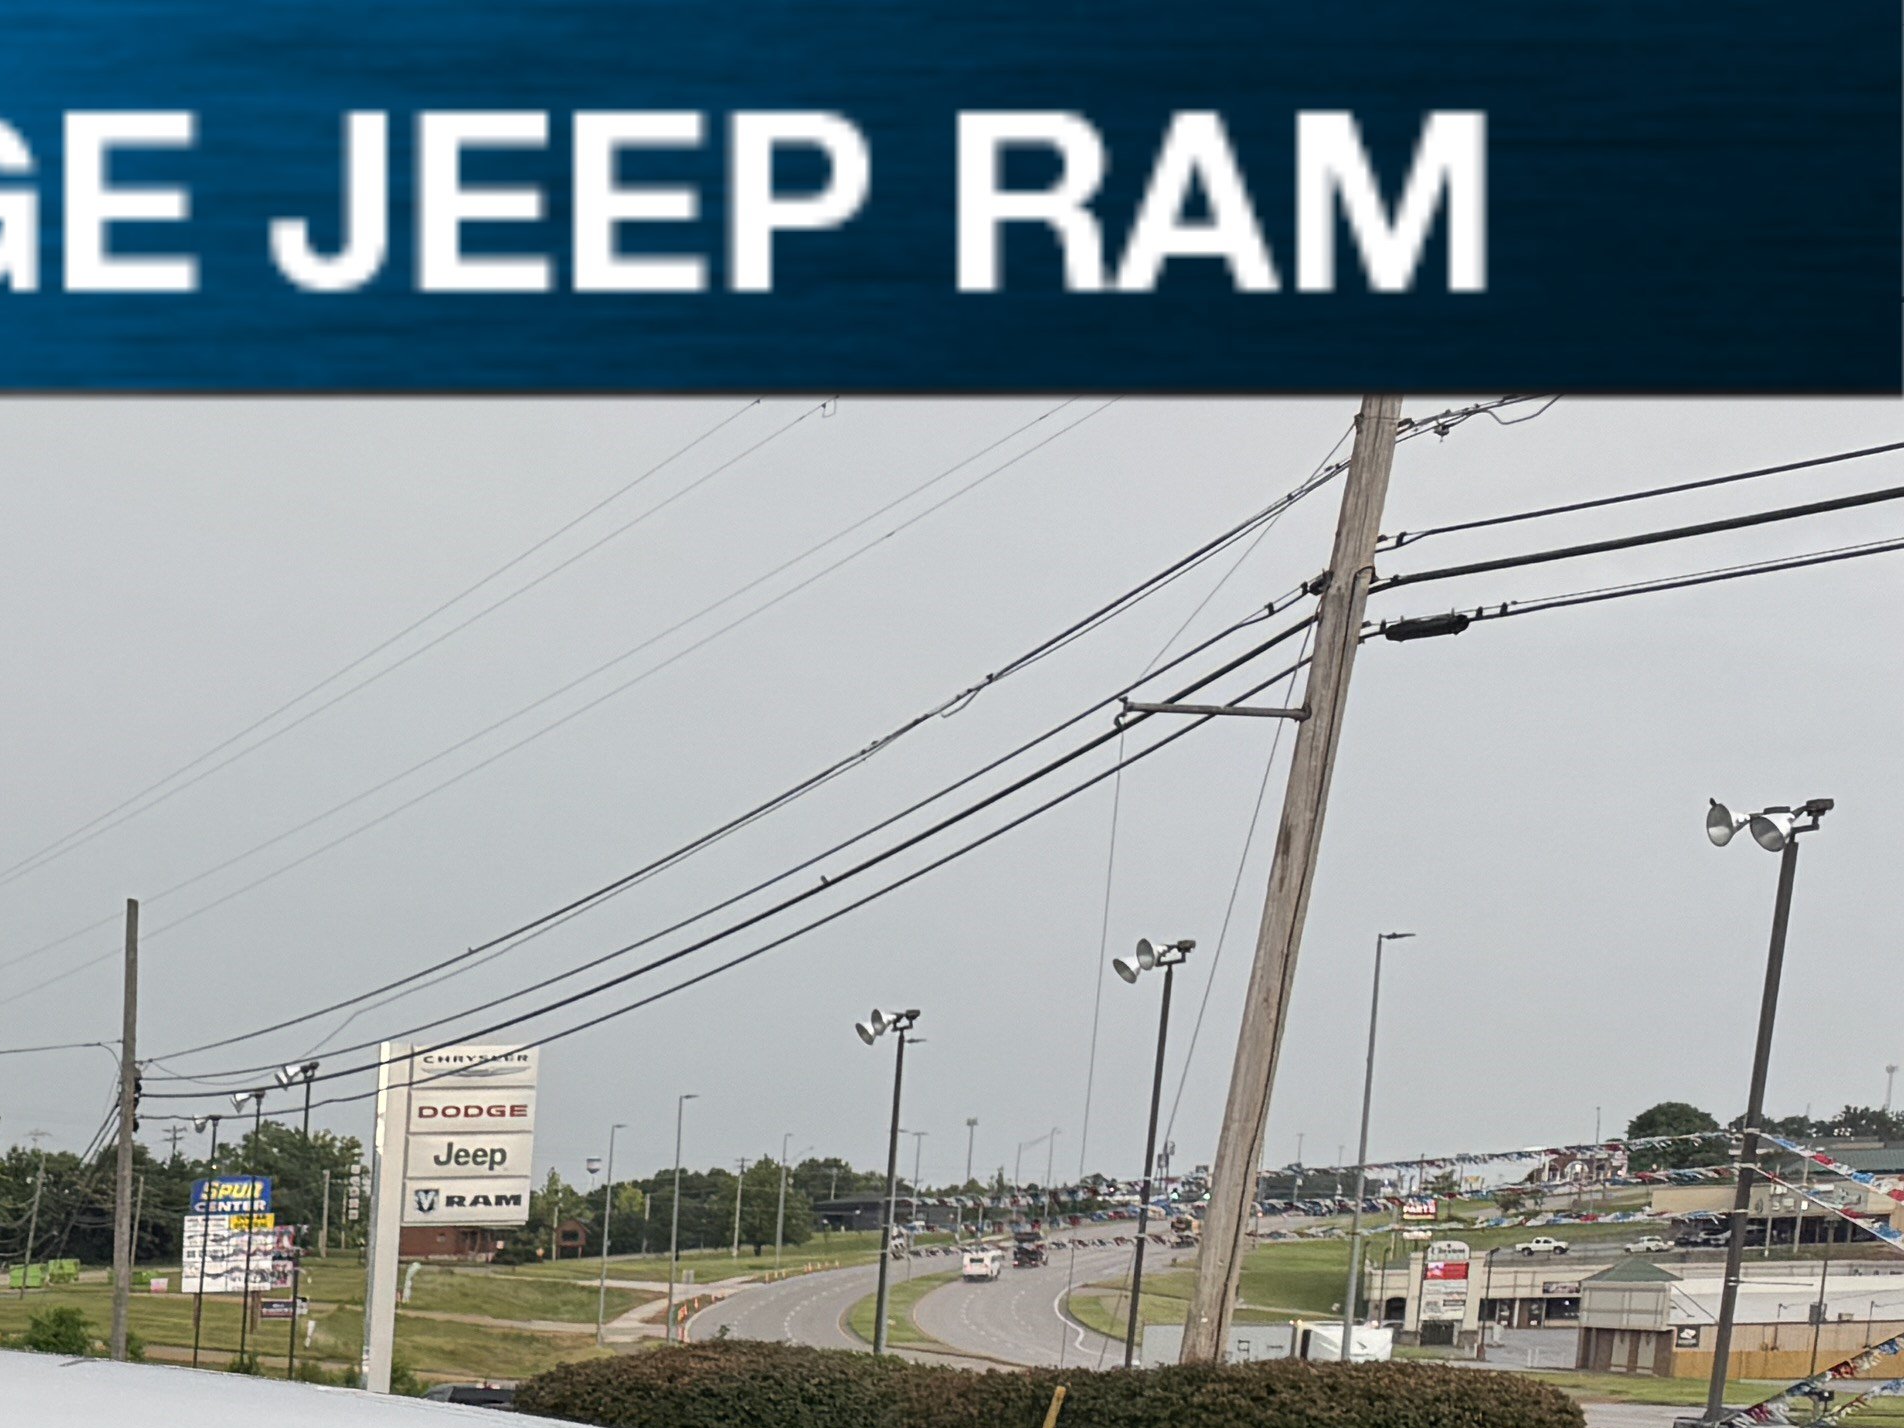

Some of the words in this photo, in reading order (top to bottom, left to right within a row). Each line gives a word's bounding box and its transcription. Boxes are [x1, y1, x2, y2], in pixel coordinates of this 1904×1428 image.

[418, 1104, 528, 1119] DODGE
[433, 1142, 508, 1171] Jeep
[194, 1200, 267, 1213] CENTER
[445, 1194, 523, 1208] RAM
